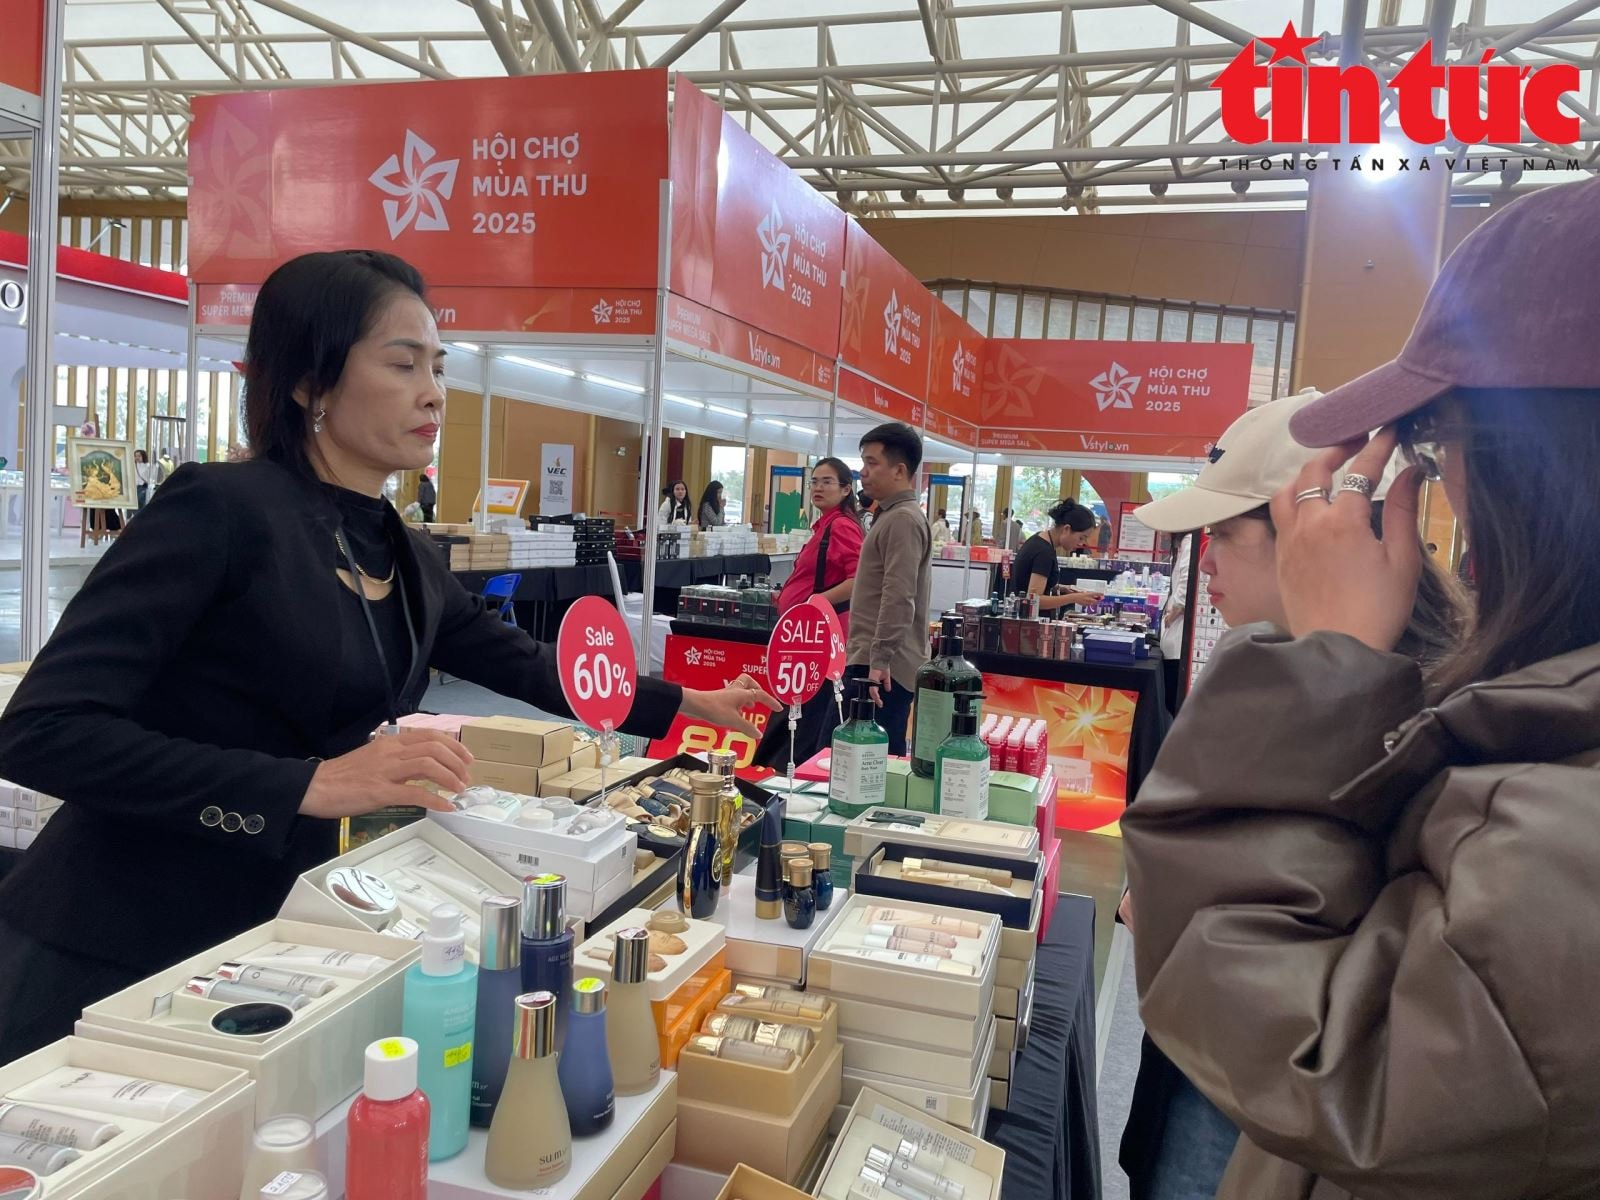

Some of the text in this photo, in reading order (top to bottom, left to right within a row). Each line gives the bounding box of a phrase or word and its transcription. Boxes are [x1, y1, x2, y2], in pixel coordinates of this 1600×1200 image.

[472, 132, 580, 168] HỘI CHỢ
[472, 168, 588, 197] MÙA THU
[472, 212, 537, 234] 2025
[795, 223, 826, 263] HỘI CHỢ
[793, 251, 827, 288] MÙA THU
[791, 282, 812, 307] 2025
[1149, 365, 1208, 383] HỘI CHỢ
[1147, 381, 1211, 396] MÙA THU
[1145, 401, 1181, 412] 2025
[547, 467, 567, 475] VEC
[585, 626, 615, 647] Sale
[780, 619, 826, 644] SALE
[573, 652, 632, 700] 60%
[806, 683, 820, 692] OFF
